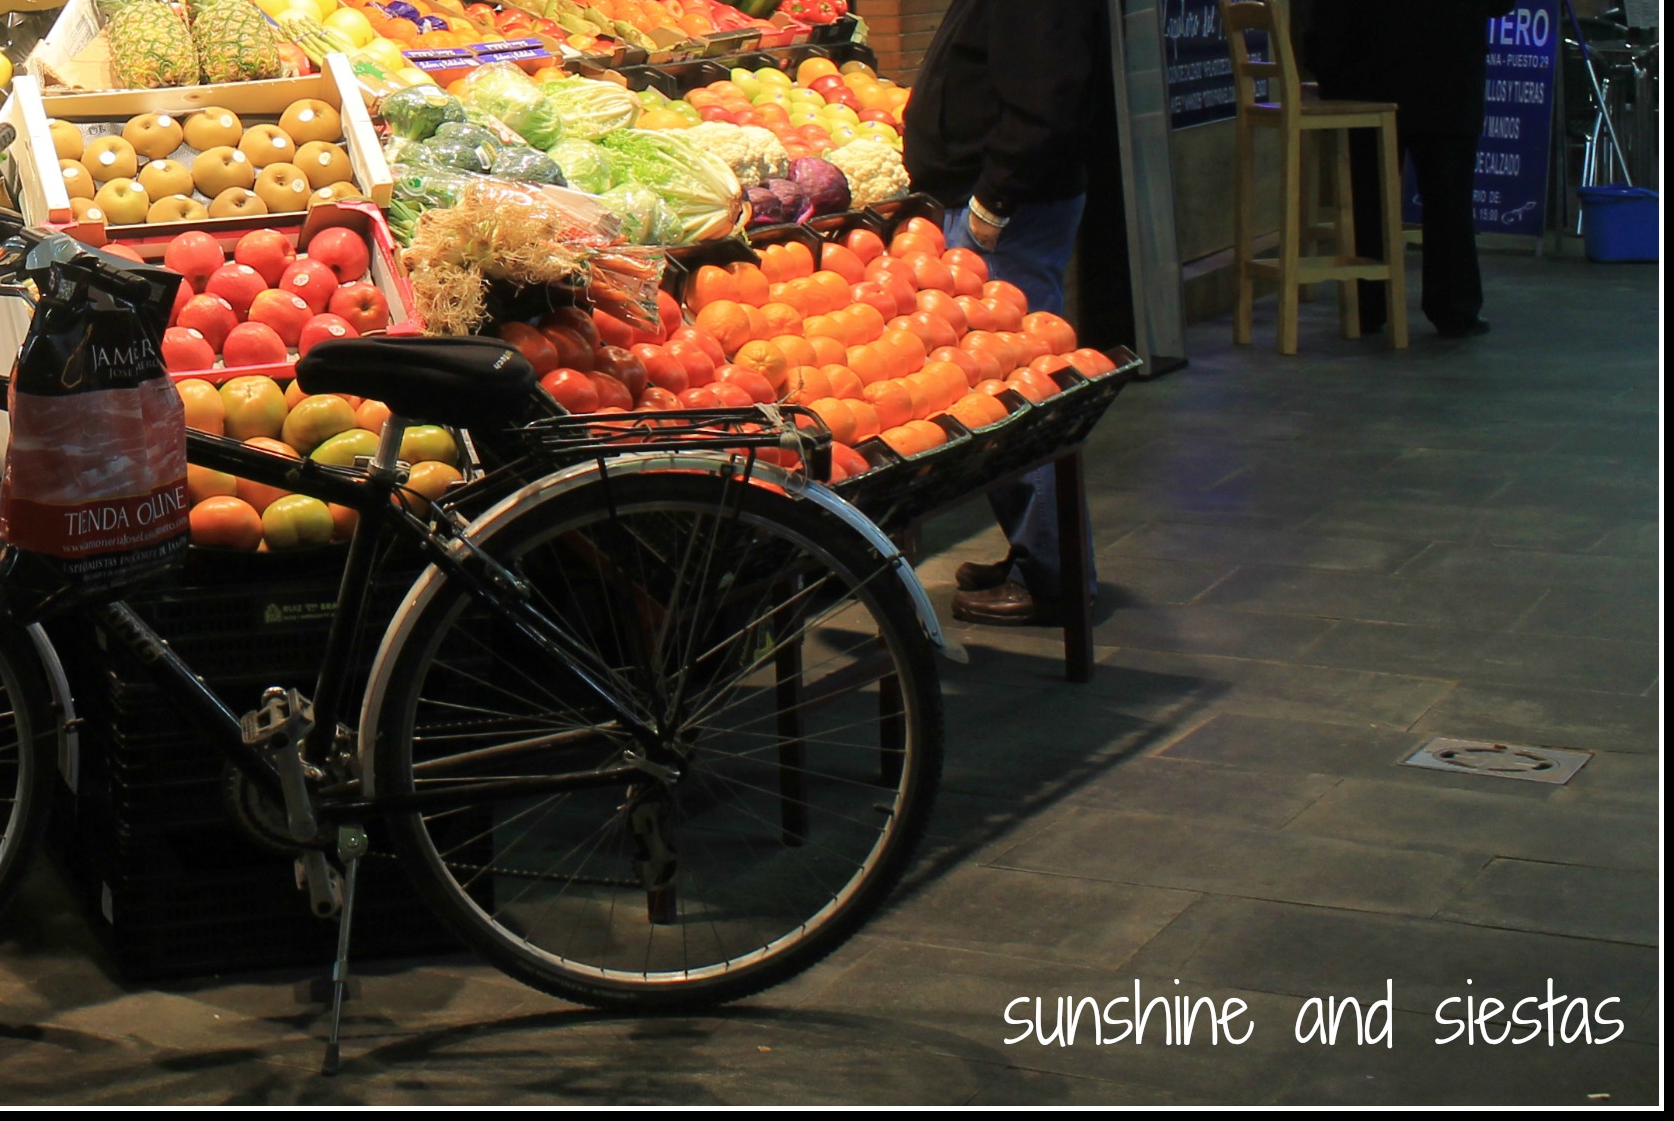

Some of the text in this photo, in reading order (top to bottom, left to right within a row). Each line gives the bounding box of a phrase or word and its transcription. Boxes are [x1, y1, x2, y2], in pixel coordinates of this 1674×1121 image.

[1507, 54, 1539, 68] PUESTO
[1488, 117, 1521, 140] MANDOS
[1485, 154, 1520, 177] CALZADO
[64, 504, 130, 536] TIENDA
